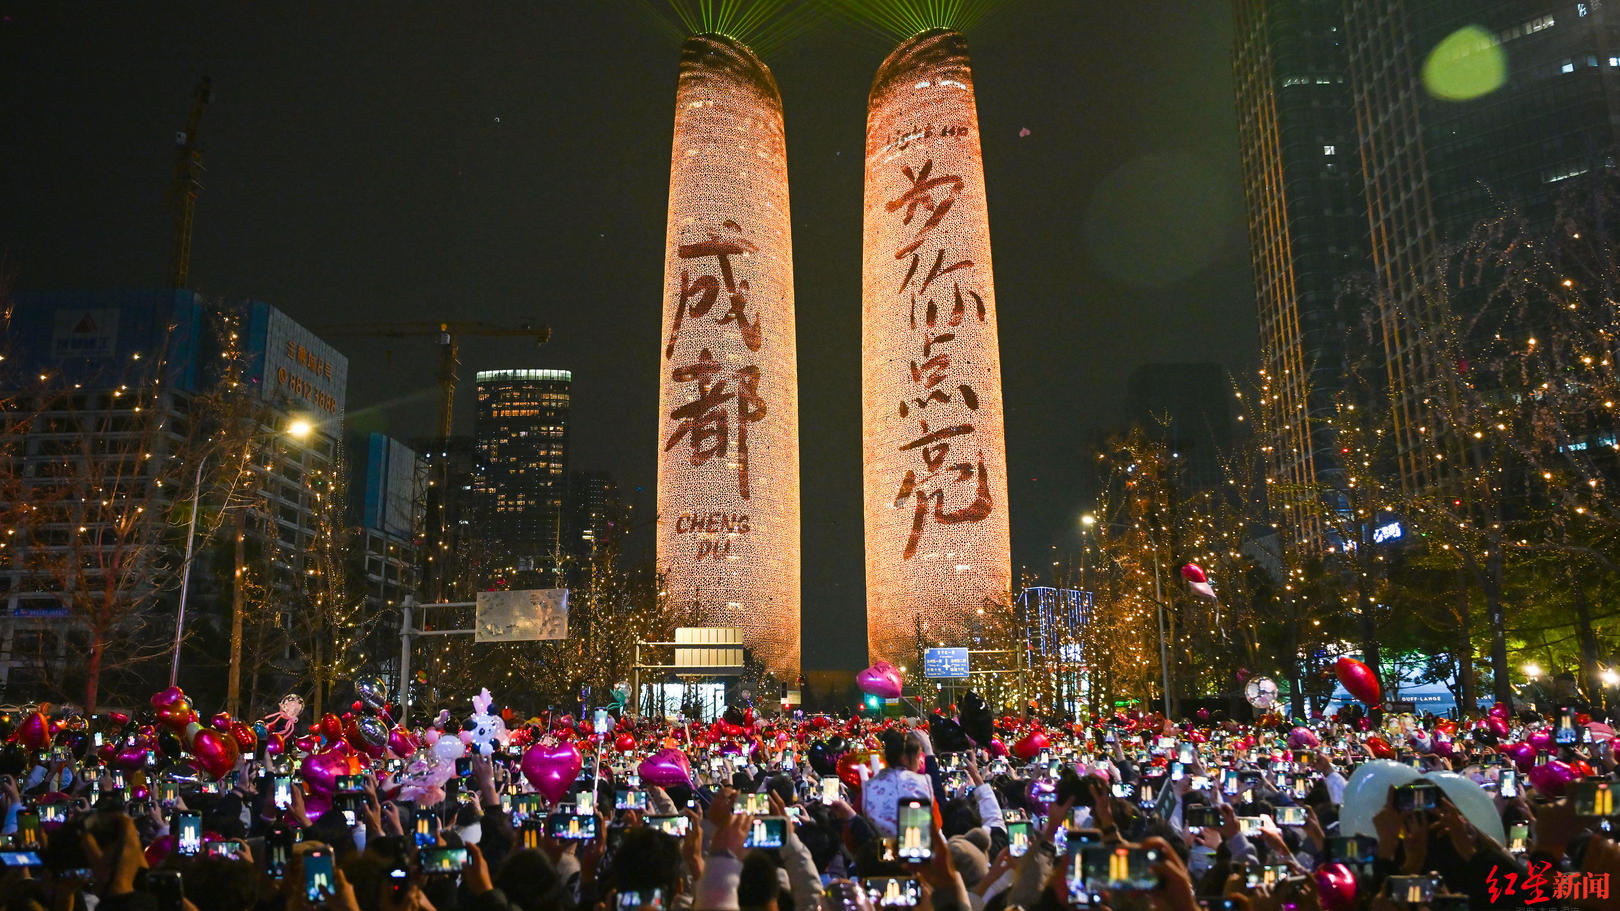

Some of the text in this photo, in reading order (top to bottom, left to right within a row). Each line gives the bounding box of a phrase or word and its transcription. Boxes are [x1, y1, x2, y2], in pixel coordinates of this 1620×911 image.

[665, 220, 767, 500] 成都
[885, 159, 994, 560] 为你点亮
[676, 512, 751, 534] CHENG
[696, 539, 731, 560] DU
